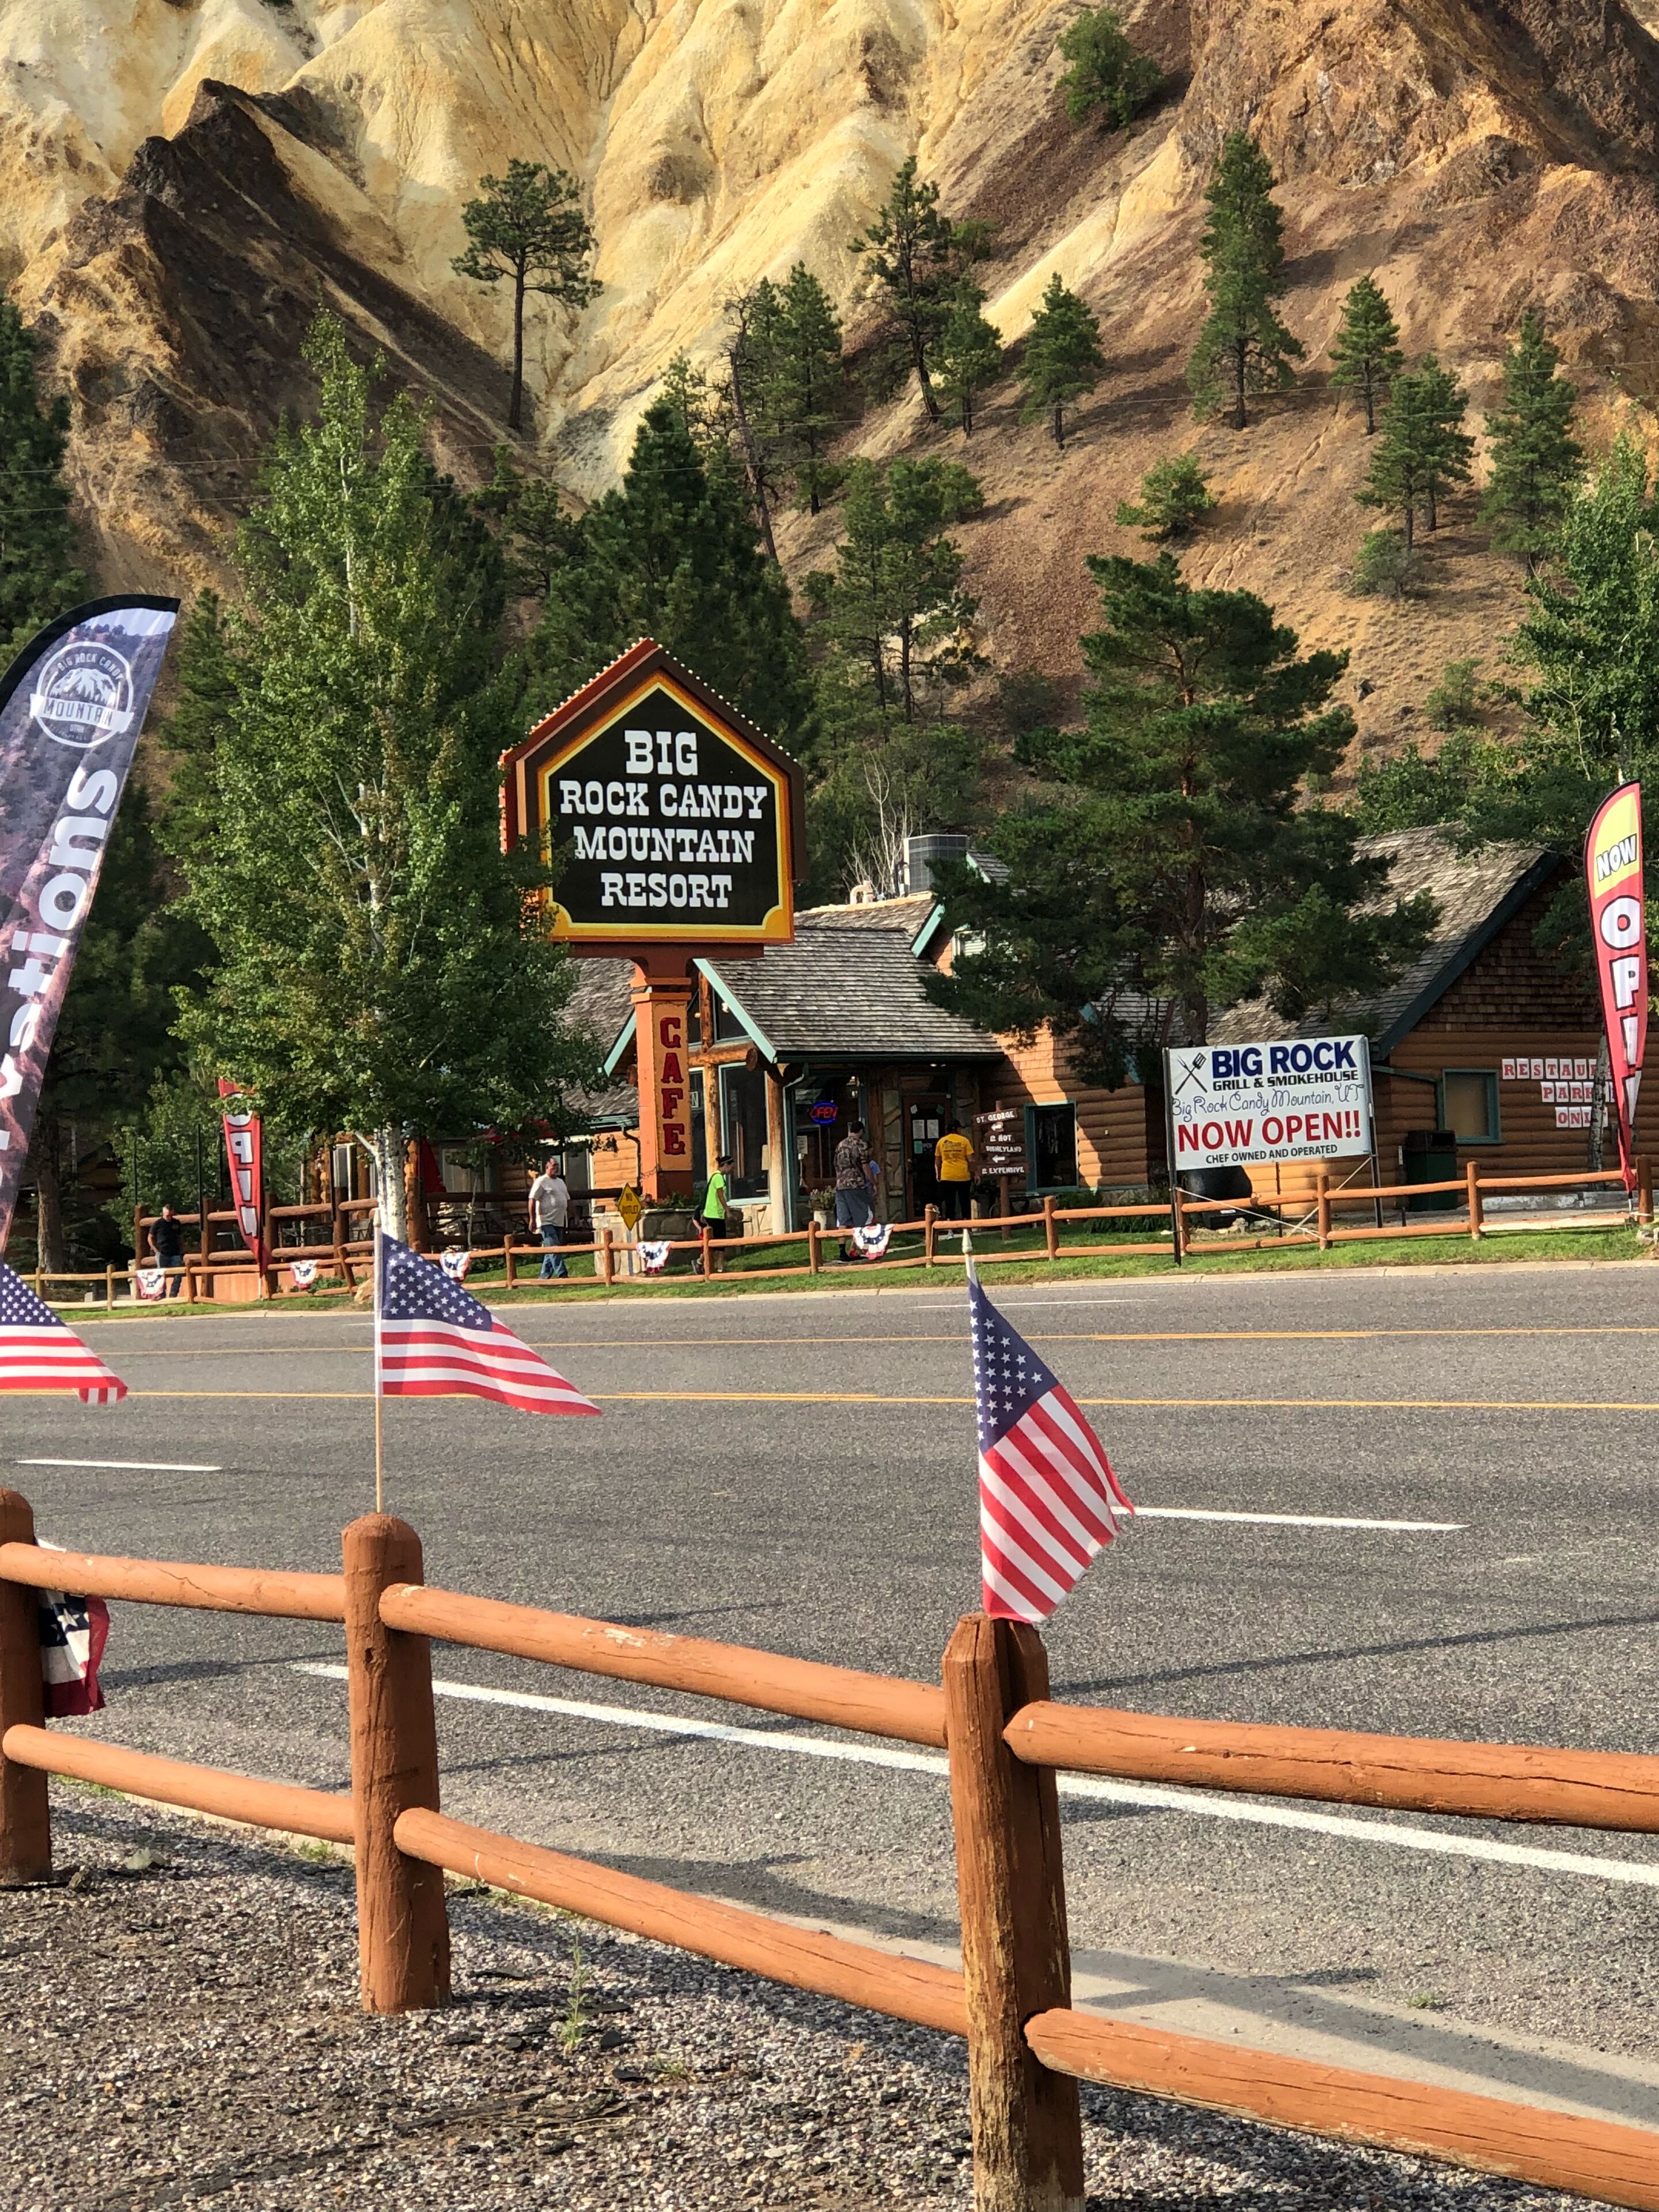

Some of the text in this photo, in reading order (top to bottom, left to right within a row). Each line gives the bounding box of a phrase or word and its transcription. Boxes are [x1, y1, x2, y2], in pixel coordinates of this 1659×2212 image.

[58, 653, 123, 680] BIG ROCK CANDY
[43, 699, 113, 727] MOUNTAIN
[624, 730, 698, 776] BIG
[559, 780, 768, 819] ROCK CANDY
[574, 826, 755, 863] MOUNTAIN
[1596, 833, 1637, 882] NOW
[601, 873, 732, 908] RESORT
[1211, 1040, 1357, 1079] BIG ROCK
[660, 1017, 685, 1155] CAFE
[1213, 1070, 1358, 1092] GRILL & SMOKEHOUSE
[810, 1107, 838, 1118] OPEN
[988, 1111, 1015, 1121] GEORGE
[1172, 1096, 1192, 1122] Big
[1193, 1095, 1228, 1114] Rock
[1229, 1090, 1269, 1116] Candy
[1334, 1083, 1364, 1102] UT
[1558, 1112, 1606, 1124] ONL
[1178, 1110, 1361, 1152] NOW OPEN!!
[1206, 1144, 1338, 1164] CHEF OWNED AND OPERATED
